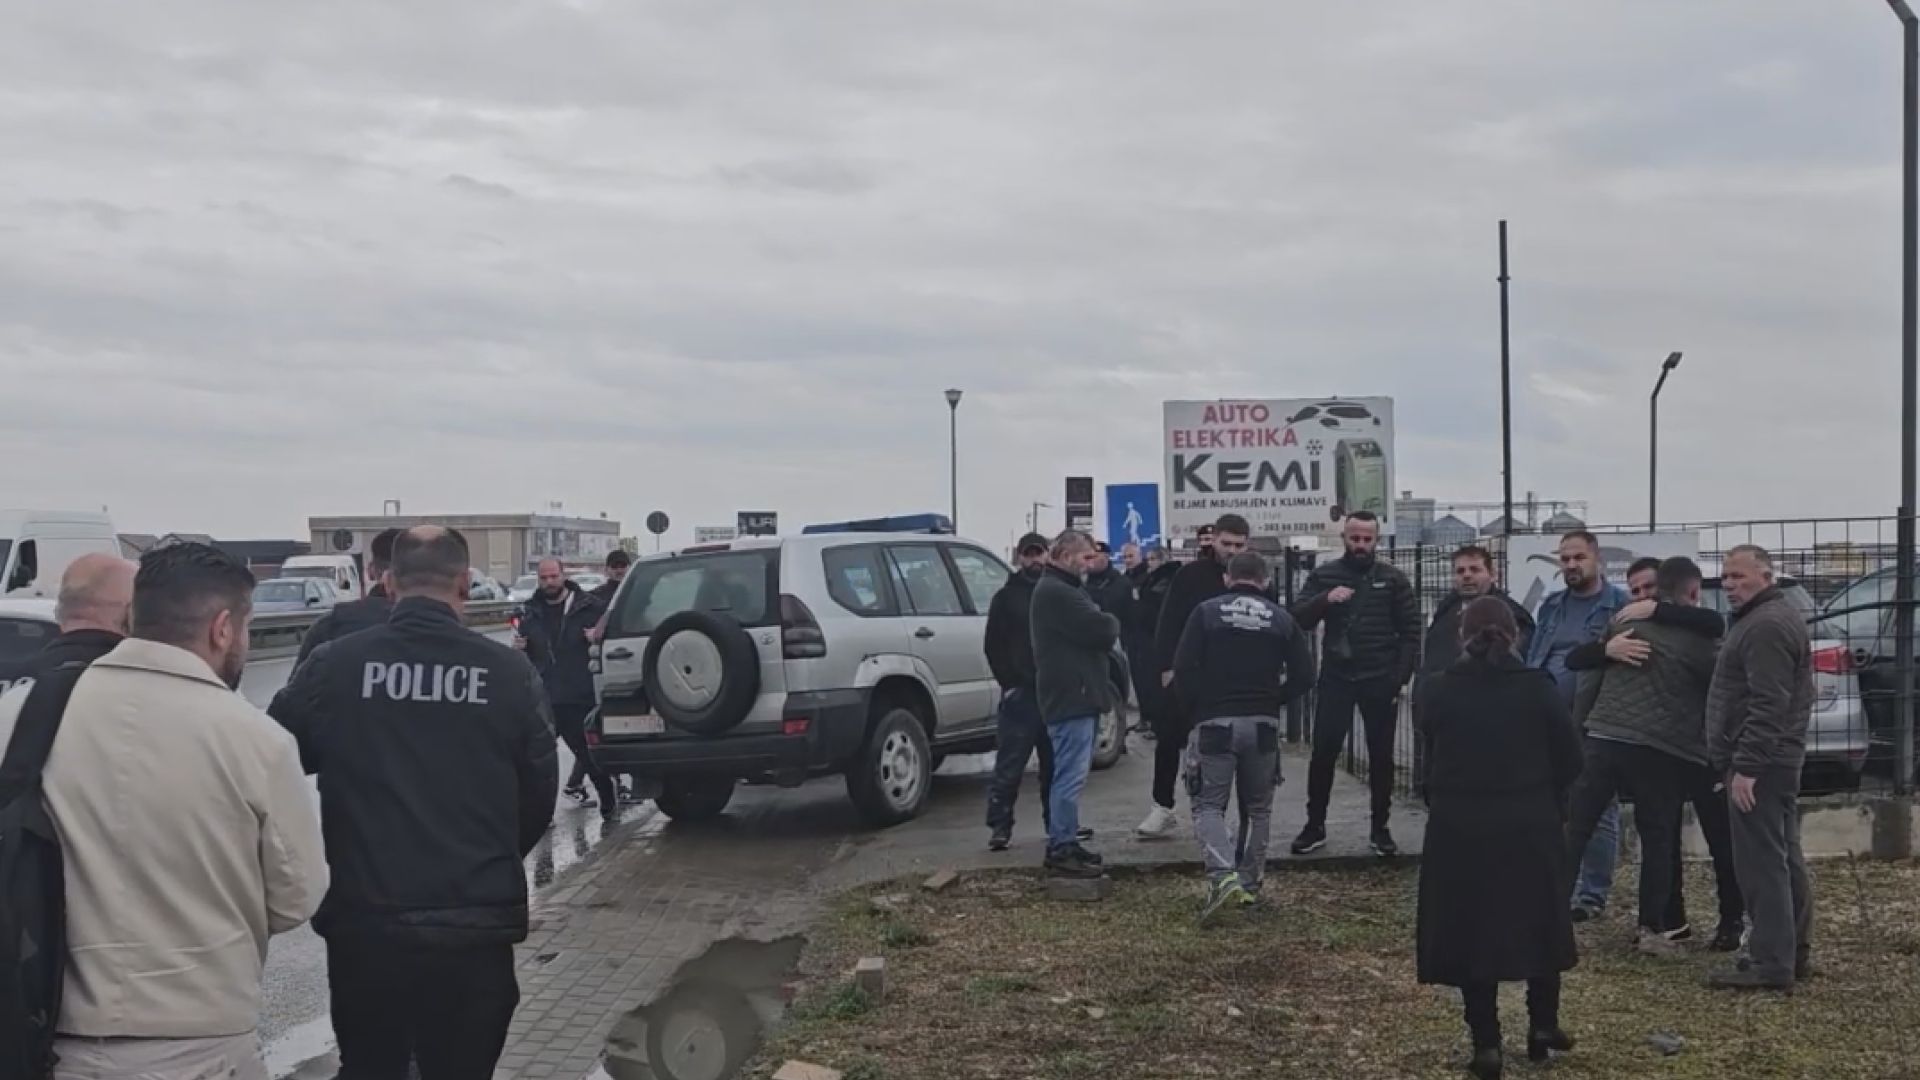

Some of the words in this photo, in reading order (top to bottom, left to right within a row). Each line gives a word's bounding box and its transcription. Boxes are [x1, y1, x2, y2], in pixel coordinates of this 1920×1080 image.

[1203, 404, 1269, 423] AUTO
[1173, 427, 1298, 448] ELEKTRIKA
[1210, 497, 1267, 508] MBUSHJEN
[1280, 496, 1327, 506] KLIMAVE
[362, 662, 488, 704] POLICE
